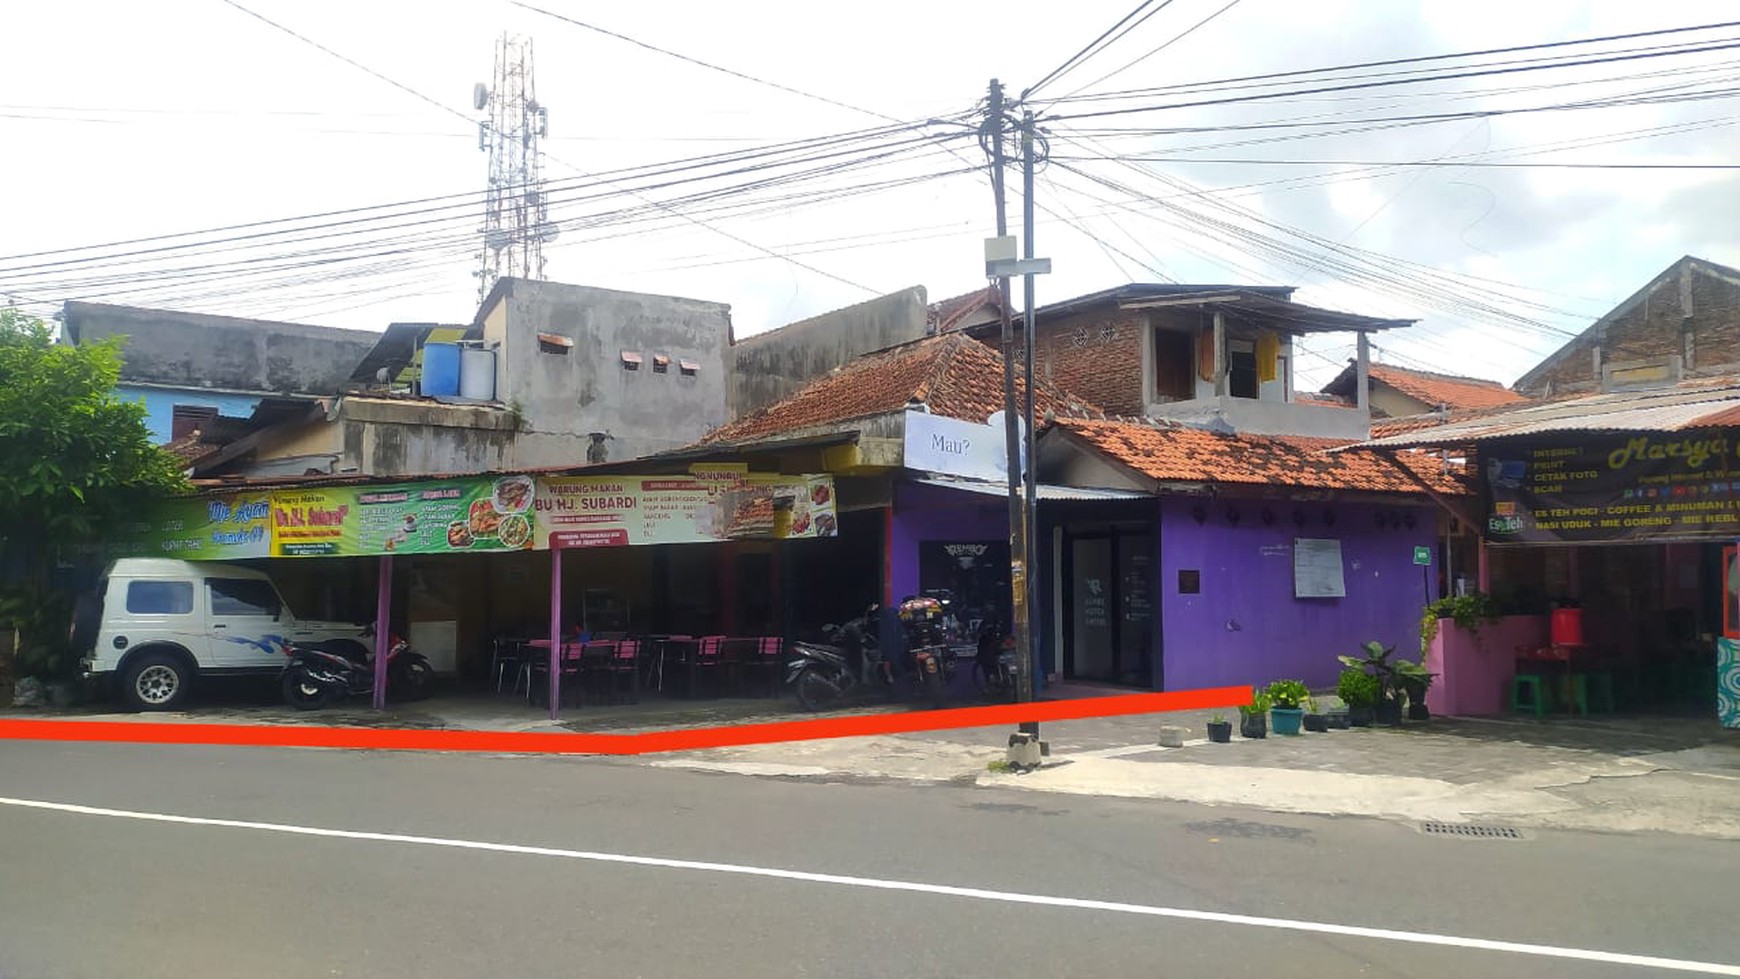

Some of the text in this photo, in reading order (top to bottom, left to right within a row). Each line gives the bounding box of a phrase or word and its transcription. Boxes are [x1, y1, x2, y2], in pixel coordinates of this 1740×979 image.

[931, 433, 971, 456] Mau?
[550, 484, 624, 494] WARUNG MAKAN
[535, 499, 552, 511] BU
[581, 496, 637, 509] SUBARDI
[1606, 504, 1652, 514] COFFEE
[1623, 516, 1672, 527] GORENG
